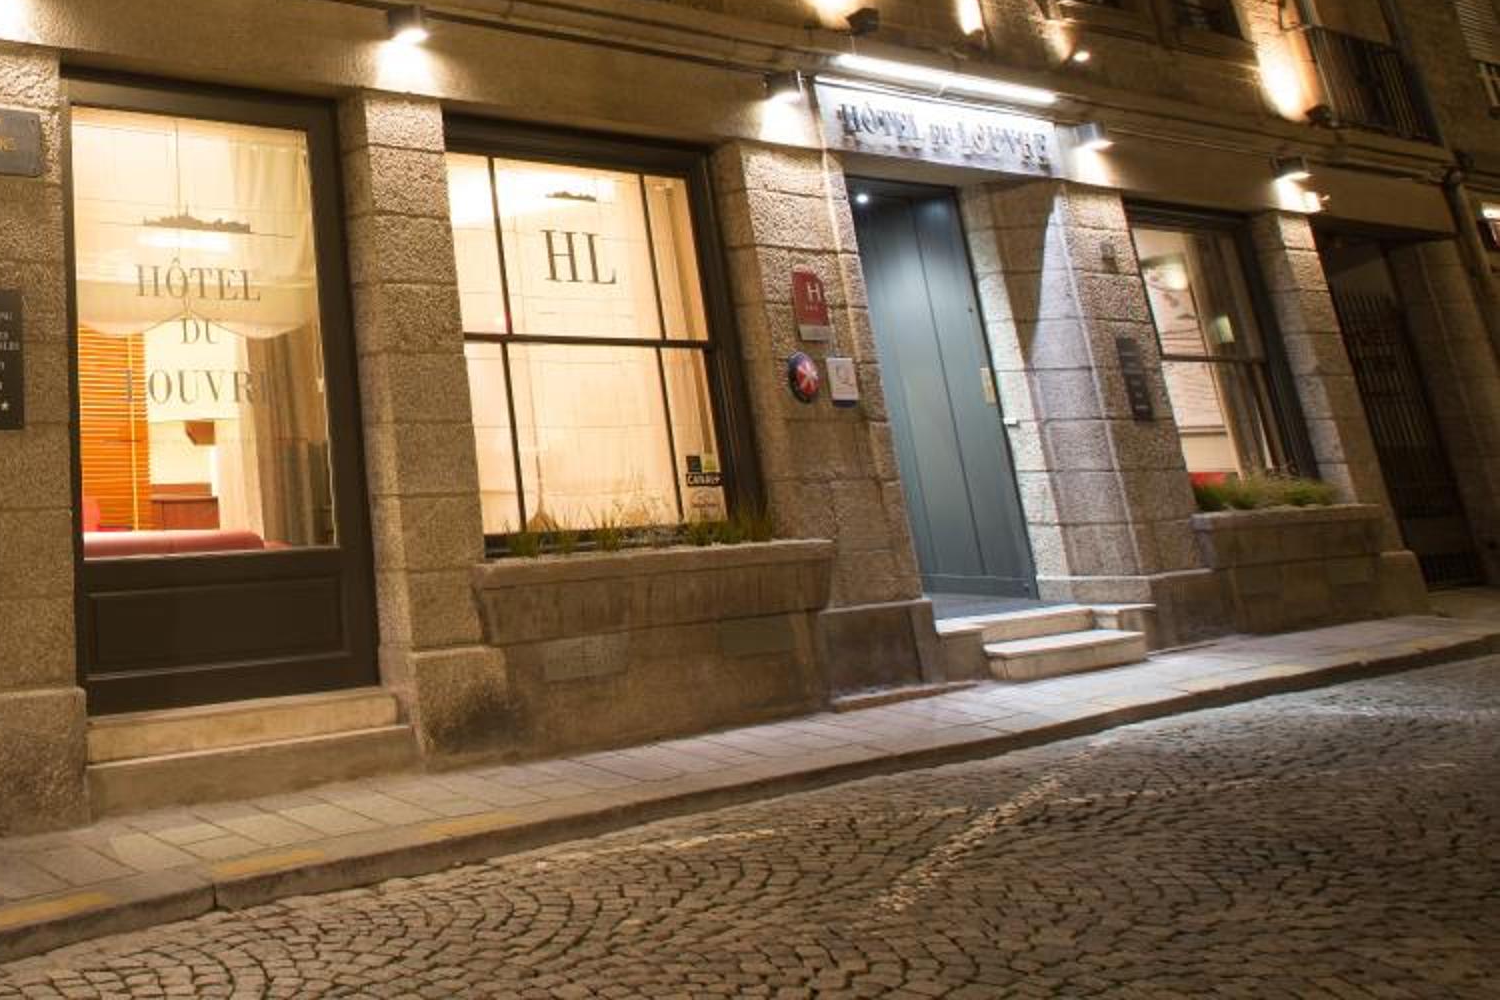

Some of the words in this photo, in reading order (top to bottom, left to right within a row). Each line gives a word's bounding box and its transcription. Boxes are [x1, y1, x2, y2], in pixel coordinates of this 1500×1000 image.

[956, 120, 1048, 159] LOUVRE
[541, 228, 617, 285] HL
[134, 257, 261, 302] HÔTEL
[807, 281, 821, 302] H
[180, 317, 220, 345] DU
